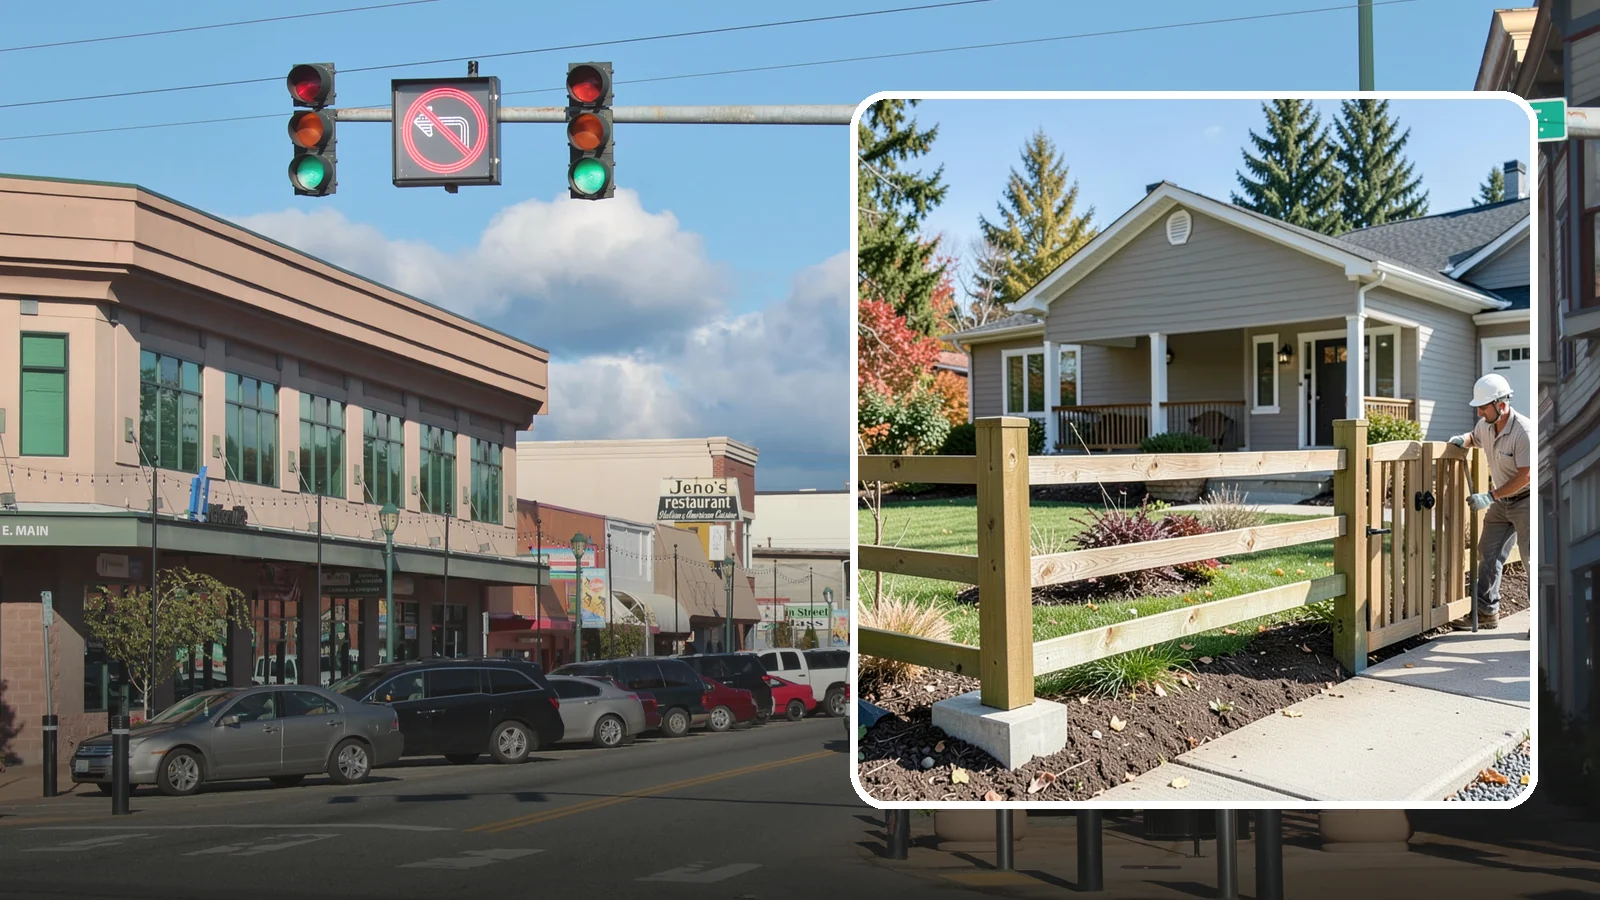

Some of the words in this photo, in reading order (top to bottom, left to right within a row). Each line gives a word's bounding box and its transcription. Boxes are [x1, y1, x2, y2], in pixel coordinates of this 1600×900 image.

[670, 480, 727, 494] Jeno's
[665, 497, 731, 509] restaurant
[659, 510, 681, 520] Italian
[686, 510, 714, 519] American
[715, 510, 737, 519] Cuisine
[2, 525, 13, 536] E.
[15, 525, 49, 536] MAIN
[786, 608, 795, 616] in
[798, 608, 828, 616] Street
[786, 619, 824, 627] lass
